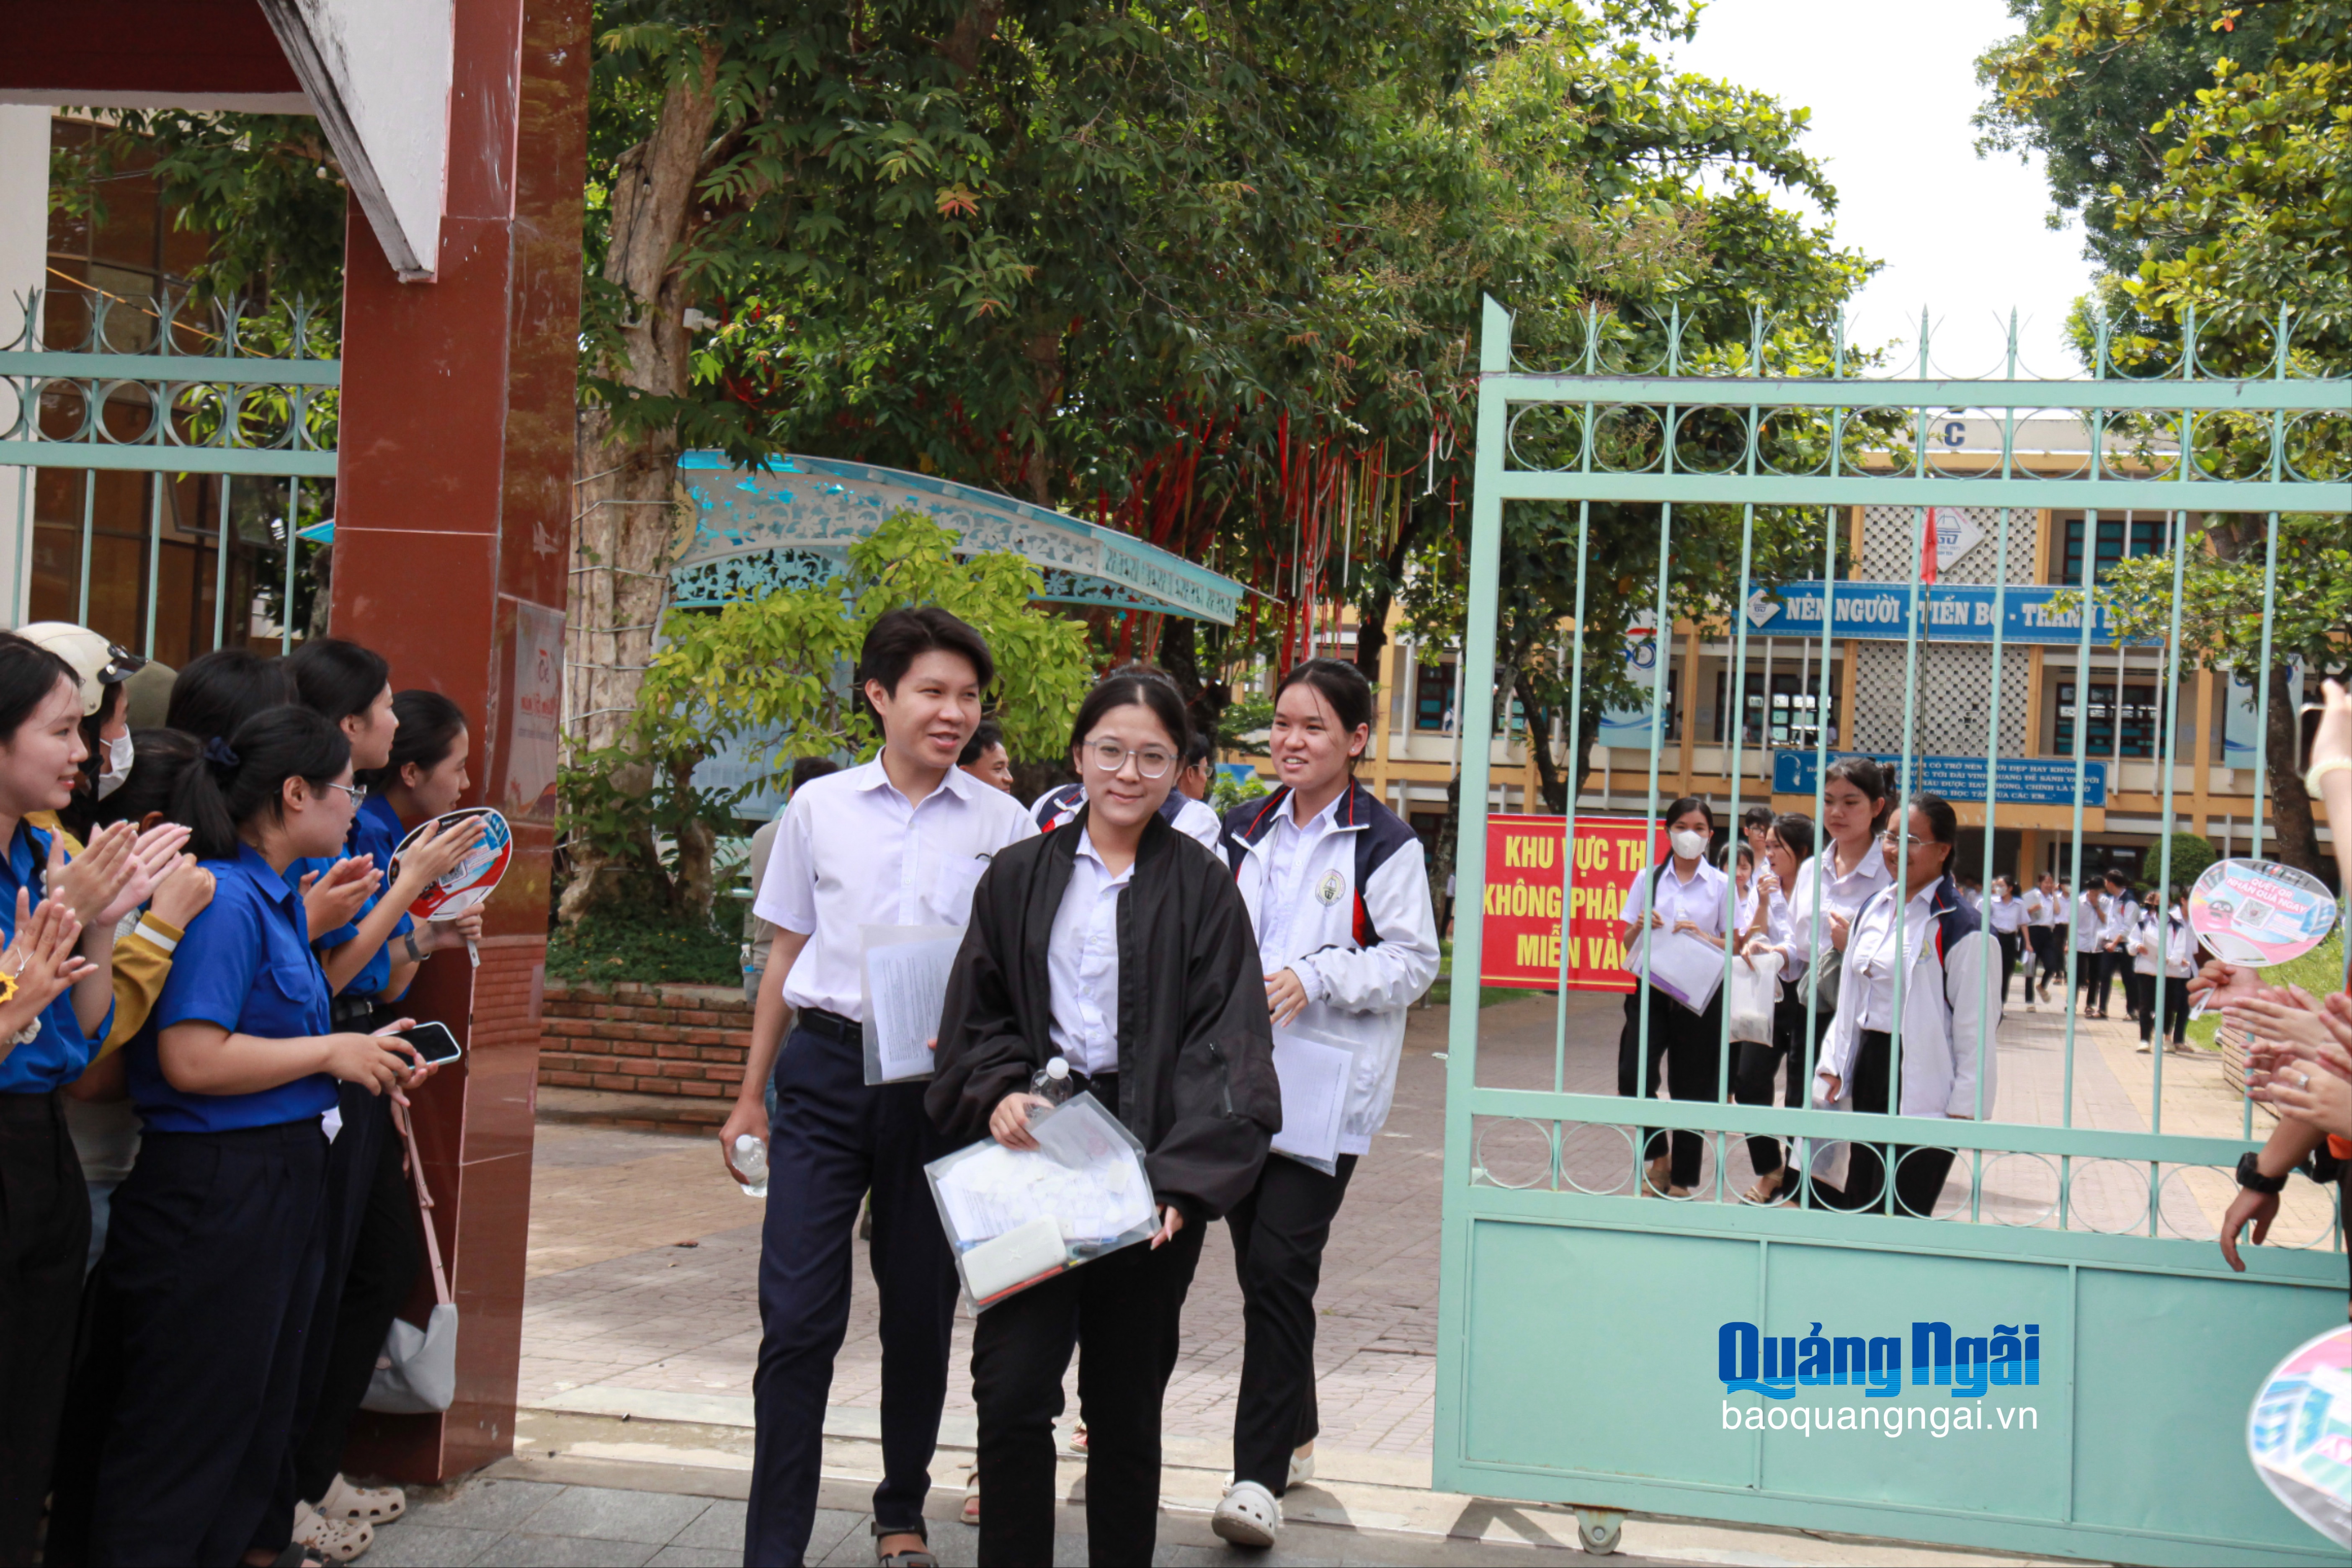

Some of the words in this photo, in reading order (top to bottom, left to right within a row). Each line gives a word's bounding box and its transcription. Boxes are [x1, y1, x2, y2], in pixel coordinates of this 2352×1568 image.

[1944, 421, 1965, 447] C
[1835, 594, 1901, 624] NGƯỜI
[2022, 603, 2097, 628] THN
[1506, 836, 1554, 869] KHU
[1483, 878, 1562, 918] KHÔNG
[1516, 924, 1581, 969] MIỄN
